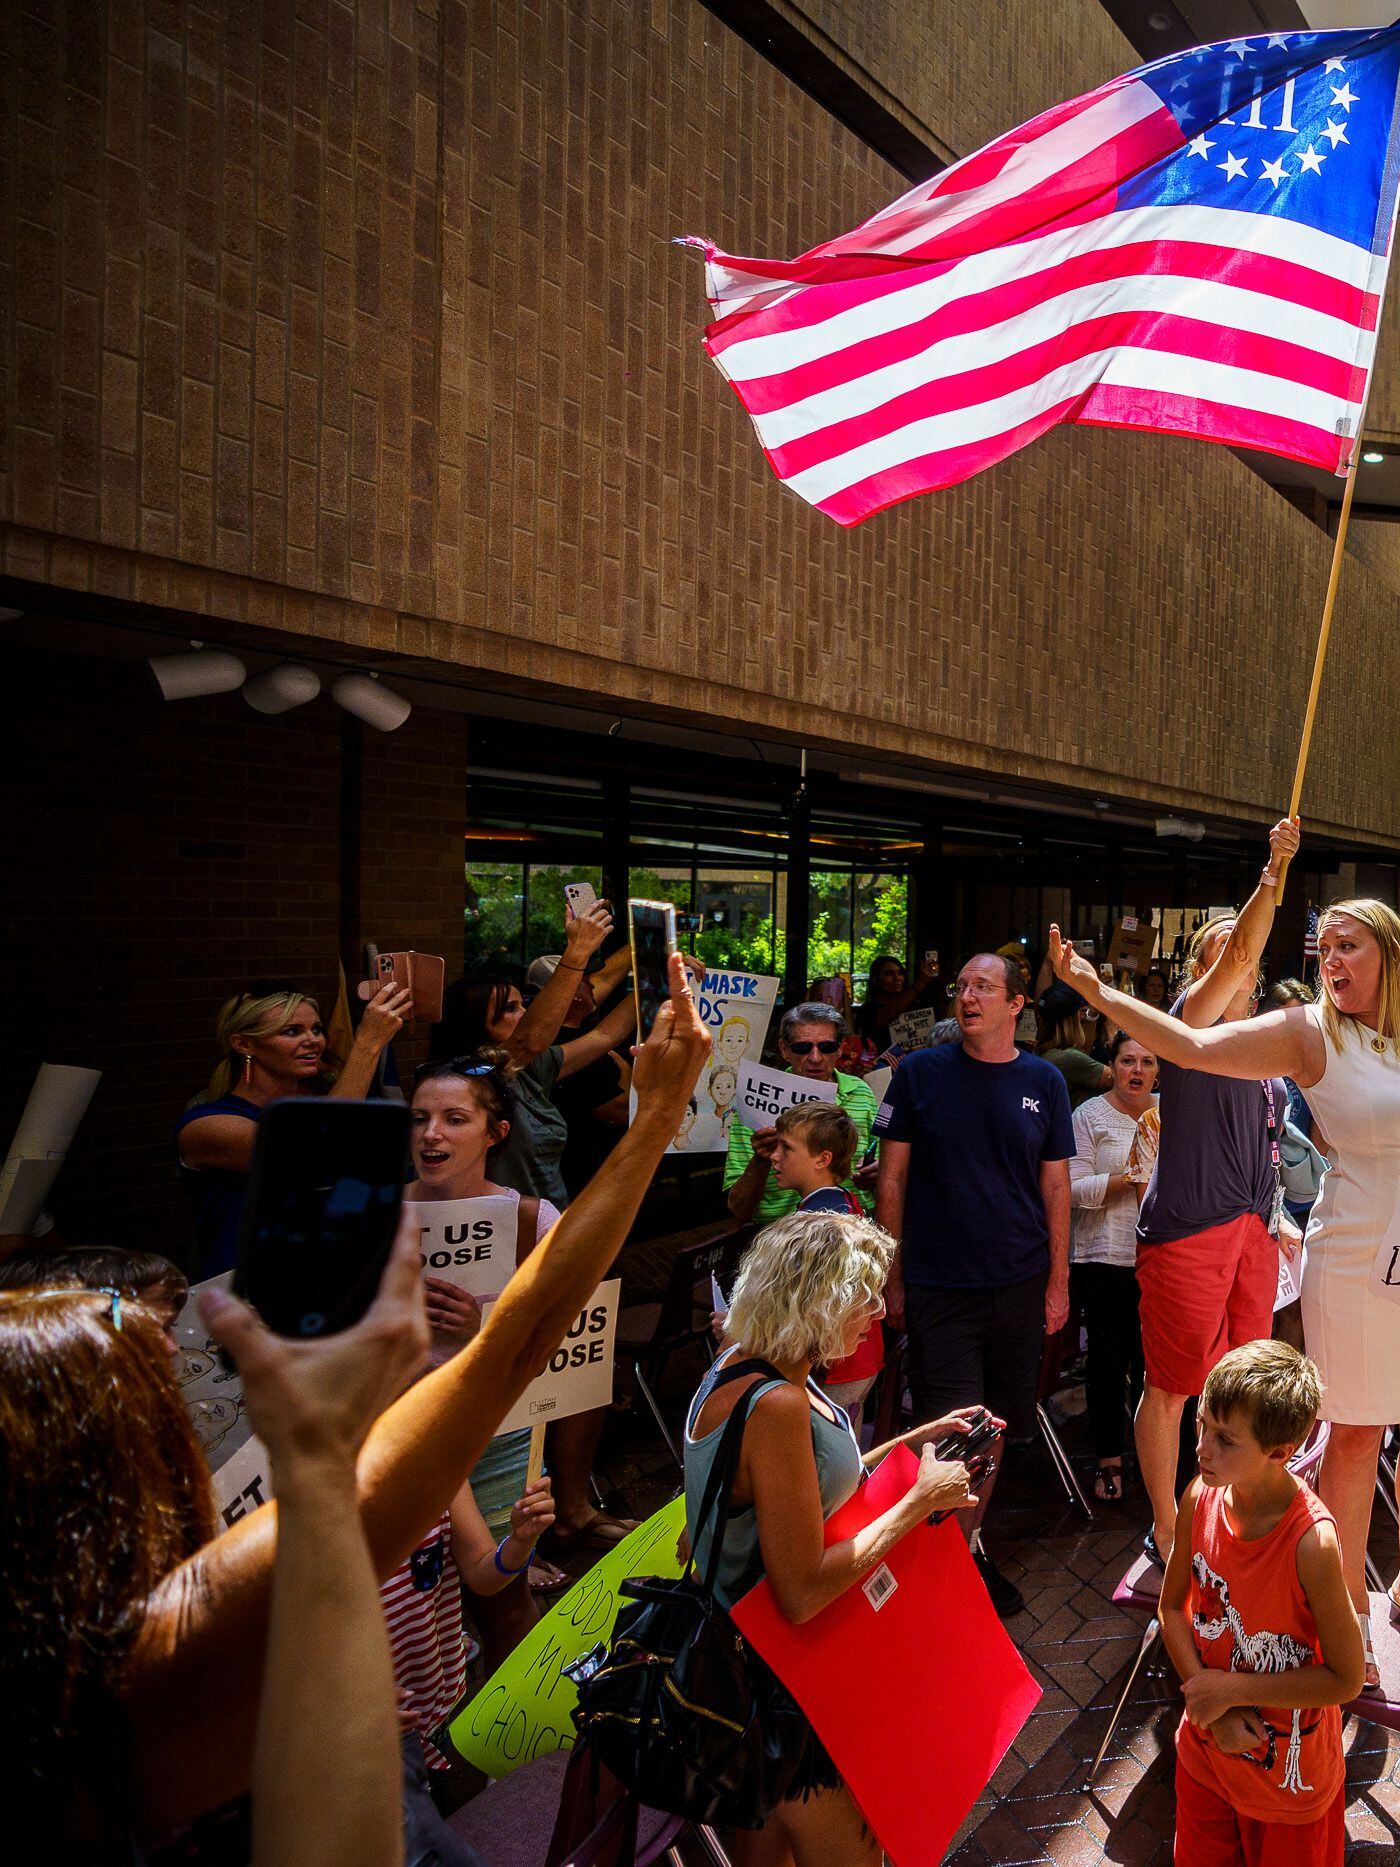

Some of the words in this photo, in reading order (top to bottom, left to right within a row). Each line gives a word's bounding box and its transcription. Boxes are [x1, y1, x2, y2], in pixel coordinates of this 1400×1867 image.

[700, 973, 759, 998] MASK
[692, 998, 729, 1027] DS
[746, 1077, 785, 1101] LET
[744, 1094, 791, 1116] CHO
[1022, 1096, 1040, 1113] PK
[444, 1220, 494, 1245] US
[420, 1243, 492, 1269] OSE
[534, 1338, 604, 1378] OSE
[221, 1474, 266, 1529] ET
[620, 1515, 673, 1577] MY
[557, 1568, 623, 1637] BOD
